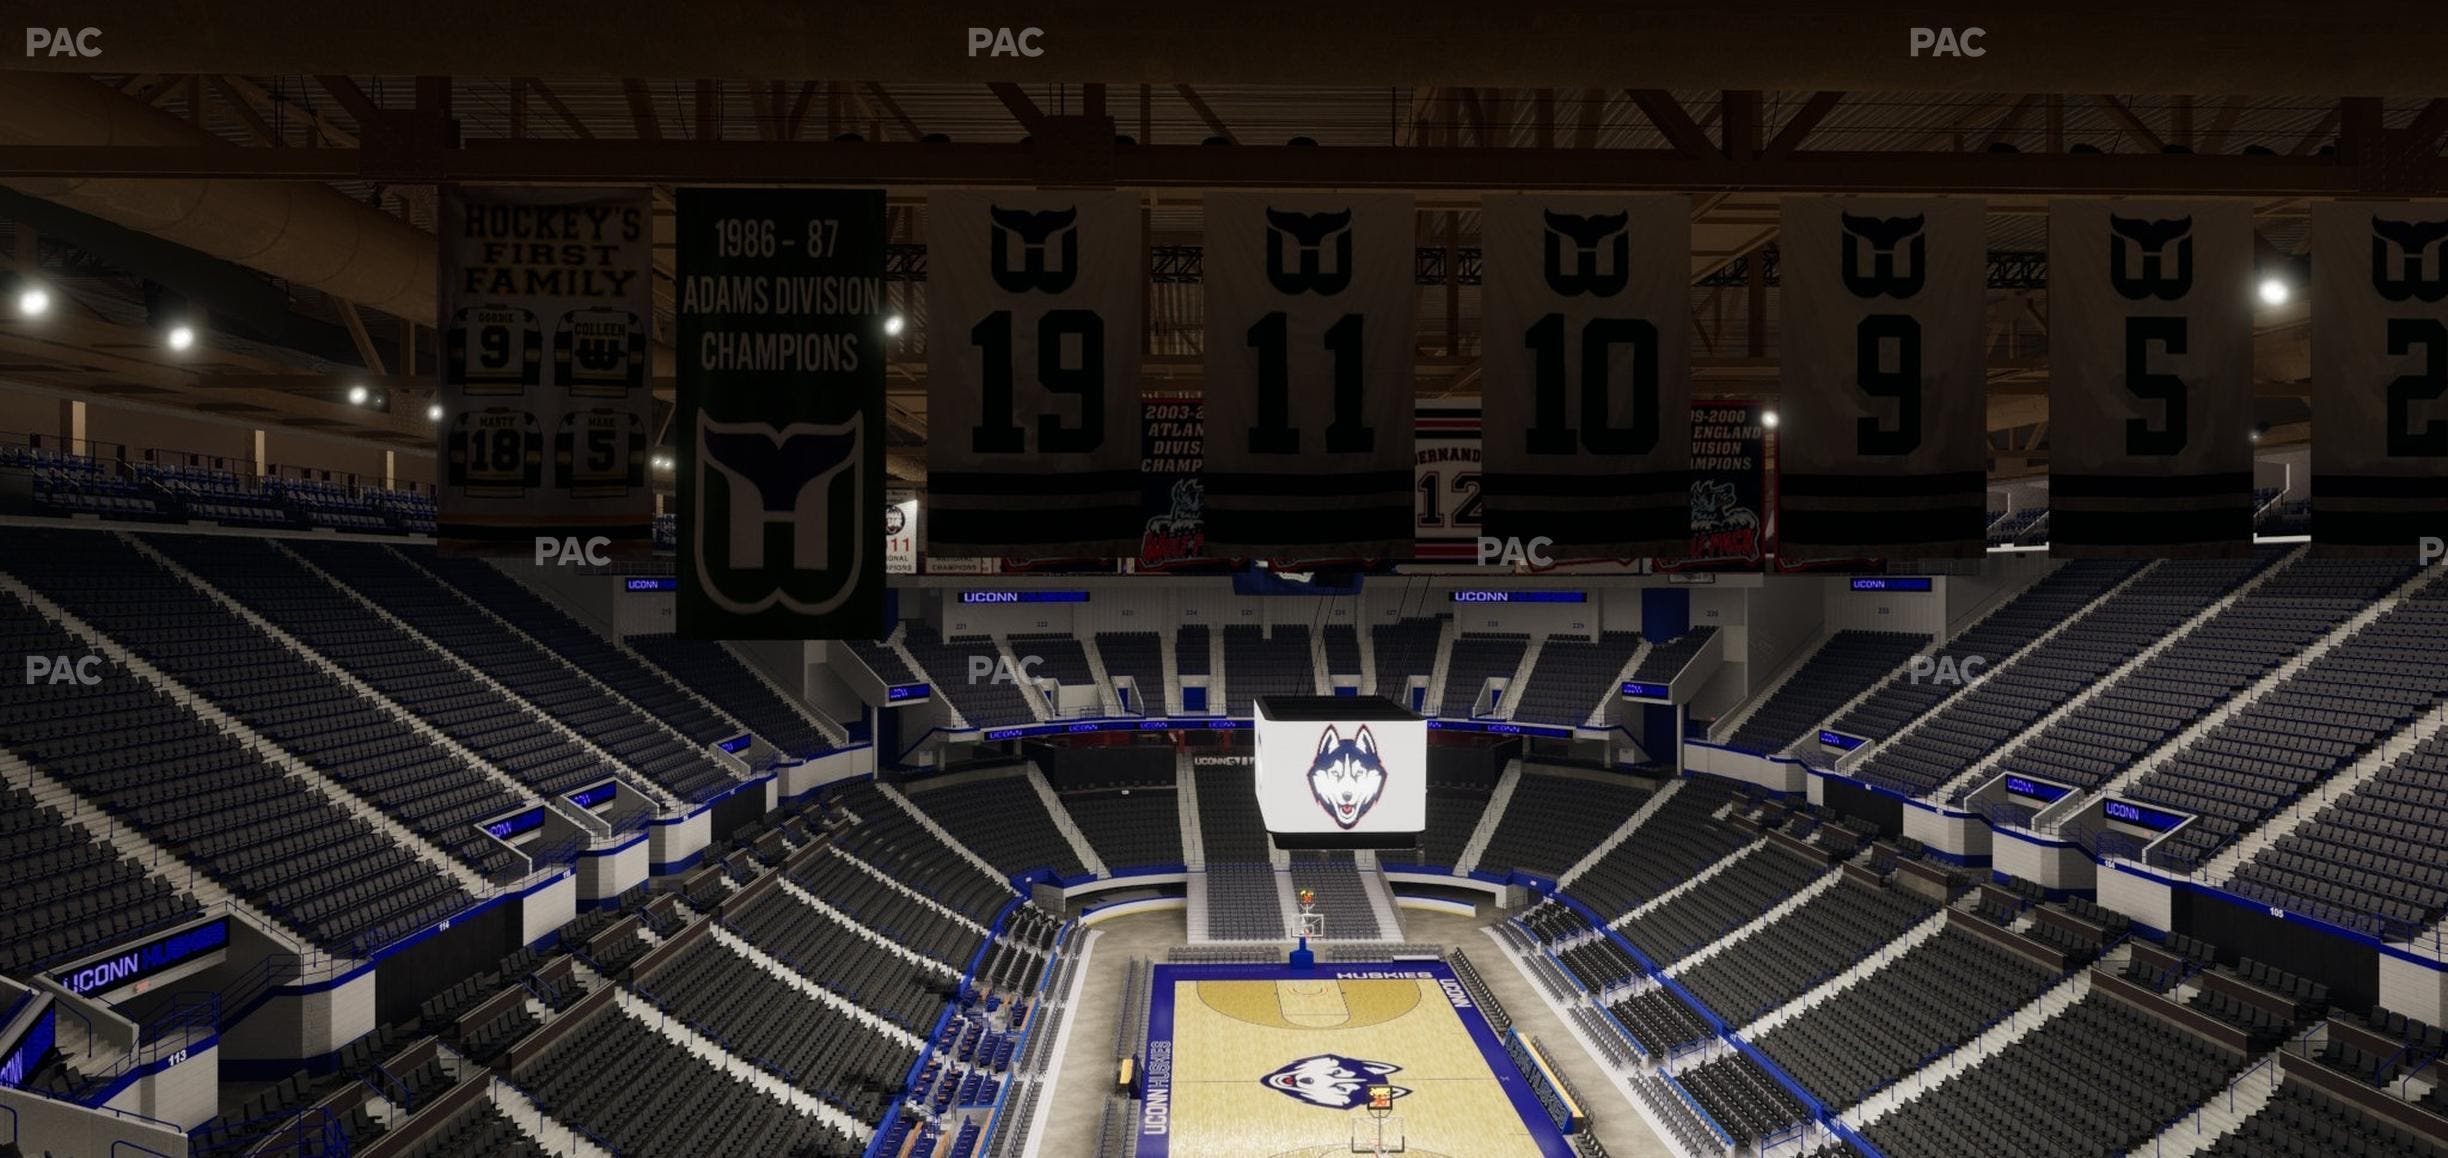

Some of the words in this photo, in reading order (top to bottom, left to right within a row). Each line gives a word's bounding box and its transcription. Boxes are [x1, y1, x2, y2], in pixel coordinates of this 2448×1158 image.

[465, 203, 641, 241] HOCKEY'S
[714, 217, 777, 259] 1986
[807, 218, 841, 259] 87
[483, 243, 619, 266] FIRST
[464, 268, 636, 296] FAMILY
[683, 274, 770, 316] ADAMS
[775, 274, 881, 317] DIVISION
[481, 325, 510, 368] 9
[574, 323, 627, 337] COLLEEN
[701, 331, 859, 373] CHAMPIONS
[972, 310, 1103, 453] 19
[1248, 312, 1374, 454] 11
[1526, 313, 1659, 455] 10
[1857, 314, 1922, 455] 9
[2126, 317, 2188, 456] 5
[2387, 318, 2448, 457] 2
[472, 429, 520, 471] 18
[588, 430, 616, 471] 5
[1693, 425, 1762, 439] ENGLAND
[1414, 446, 1481, 466] ERNAND
[1417, 471, 1485, 528] 12
[628, 579, 658, 590] UCONN
[963, 591, 1018, 602] UCONN
[1454, 591, 1508, 602] UCONN
[1852, 579, 1885, 589] UCONN
[2105, 802, 2139, 822] UCONN
[63, 952, 139, 994] UCONN
[1336, 971, 1434, 980] HUSKIES
[1439, 979, 1473, 1008] UCONN
[167, 1049, 188, 1067] 113
[1148, 1040, 1172, 1088] HUSKIES
[1144, 1088, 1169, 1135] UCONN
